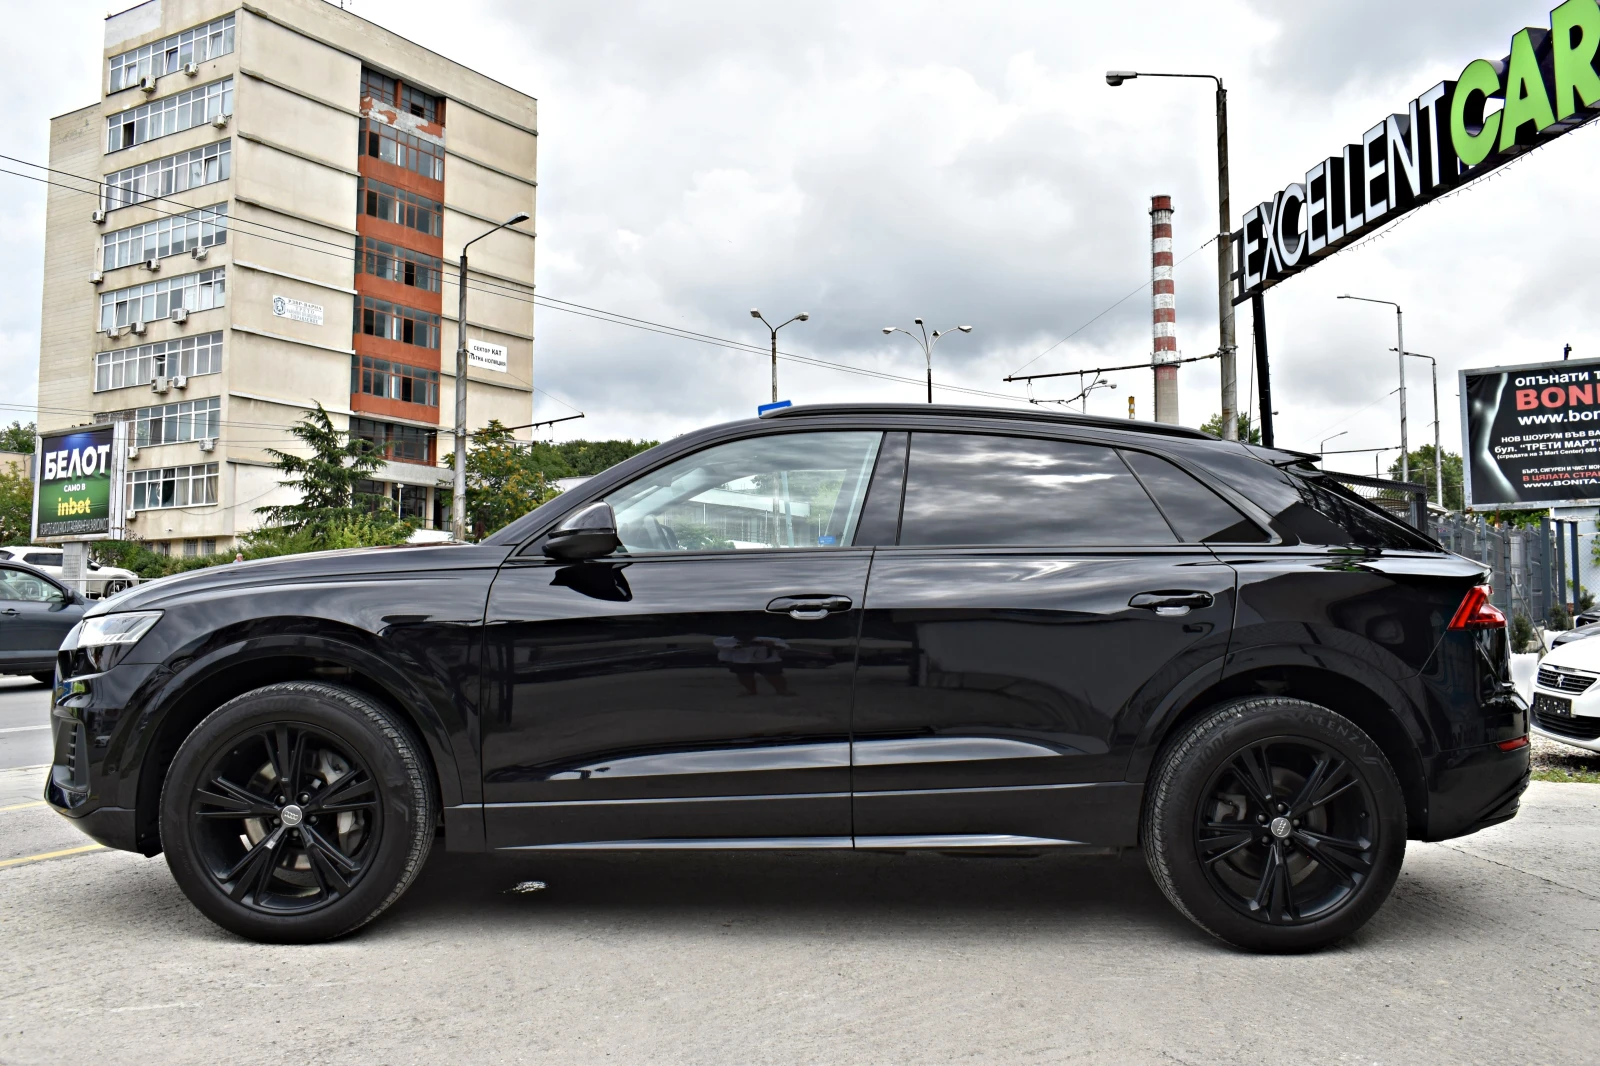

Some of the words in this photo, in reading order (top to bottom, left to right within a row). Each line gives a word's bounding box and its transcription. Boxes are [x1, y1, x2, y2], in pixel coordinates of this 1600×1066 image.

[1243, 80, 1445, 290] EXCELLENT
[473, 345, 490, 353] СЕКТОР
[492, 348, 502, 356] КАТ
[1501, 435, 1521, 443] НОВ
[1523, 432, 1563, 442] ШОУРУМ
[1564, 430, 1586, 438] ВЪВ
[1494, 446, 1518, 455] бул.
[44, 444, 110, 480] БЕЛОТ
[1532, 473, 1571, 482] ЦЯЛАТА
[64, 484, 80, 492] САМО
[82, 483, 86, 491] В
[58, 497, 90, 516] inbet
